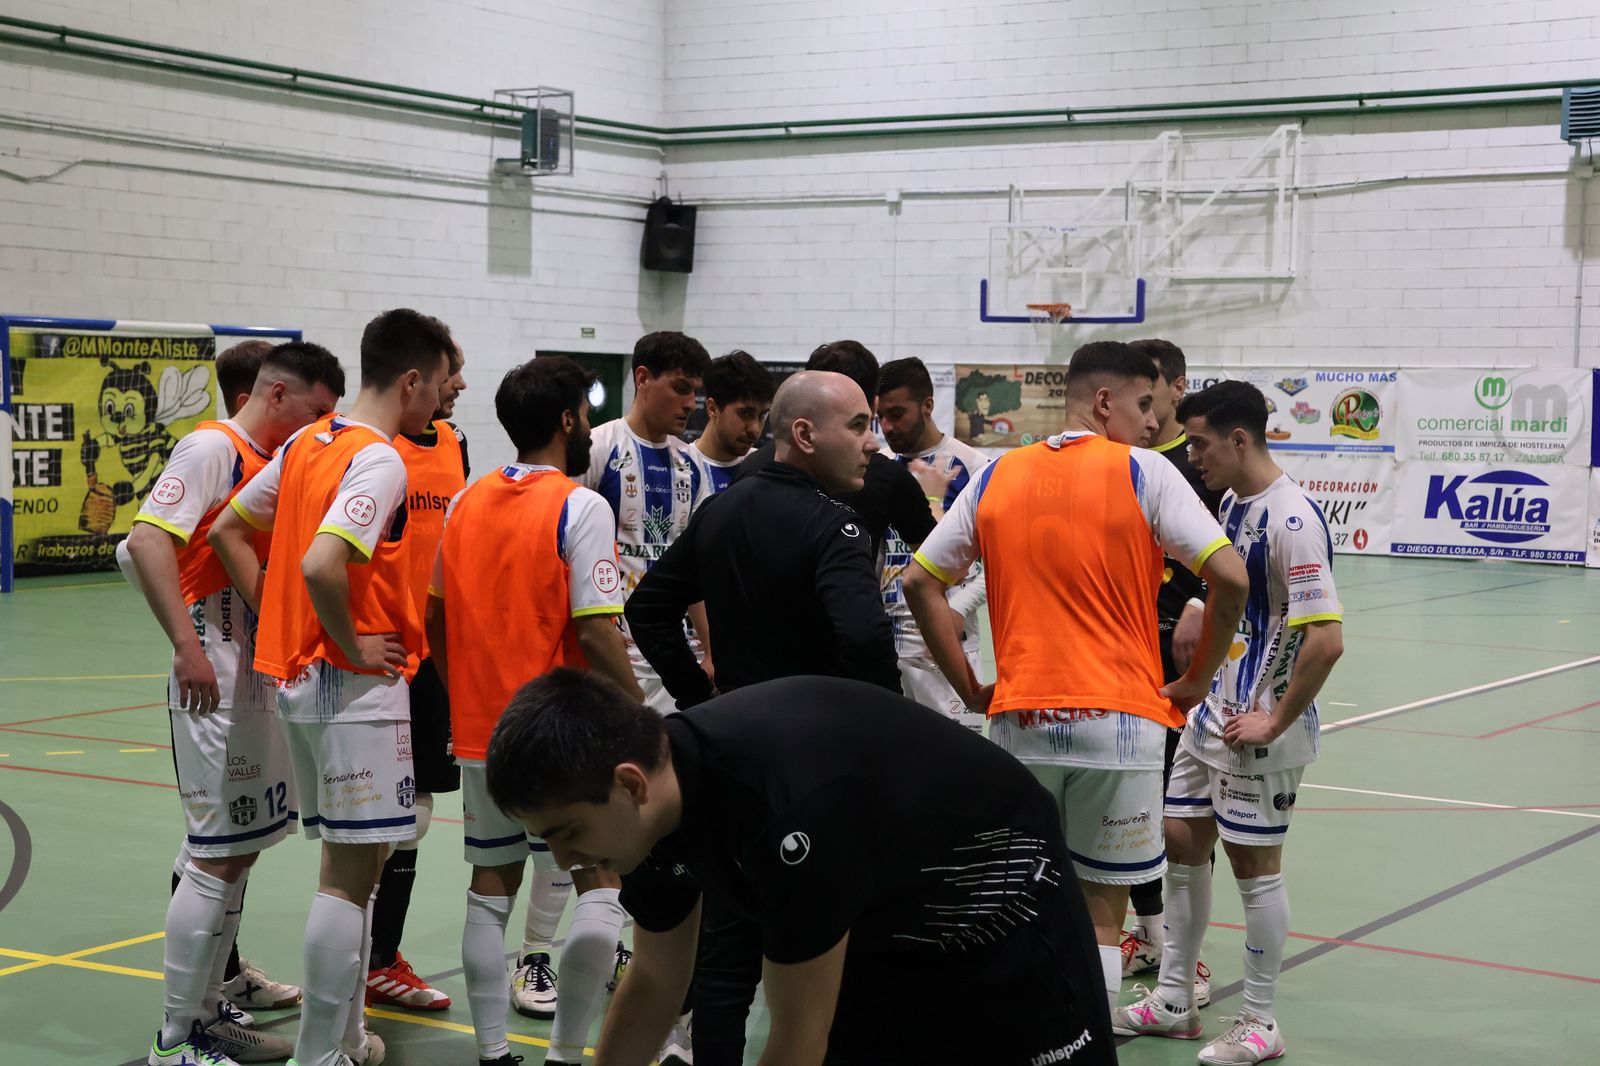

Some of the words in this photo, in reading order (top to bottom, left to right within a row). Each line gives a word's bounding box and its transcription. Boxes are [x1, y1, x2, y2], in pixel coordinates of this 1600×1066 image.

[64, 337, 199, 358] @MMonteAliste
[1315, 372, 1364, 382] MUCHO
[1417, 416, 1504, 431] comercial
[1510, 417, 1568, 433] mardi
[1418, 440, 1463, 448] PRODUCTOS
[1464, 440, 1474, 448] DE
[1475, 441, 1507, 449] LIMPIEZA
[1441, 451, 1461, 461] 680
[1463, 452, 1476, 462] 35
[1479, 453, 1491, 462] 87
[1494, 453, 1505, 463] 17
[1515, 453, 1566, 464] ZAMORA
[1308, 479, 1378, 493] DECORACIÓN
[1424, 474, 1550, 524] Kalúa
[1332, 532, 1348, 546] 37
[1397, 544, 1406, 552] C/
[1406, 545, 1434, 553] DIEGO
[1436, 546, 1448, 554] DE
[1449, 547, 1487, 555] LOSADA,
[1489, 548, 1504, 556] S/N
[1511, 549, 1527, 557] TLF.
[1530, 550, 1545, 558] 980
[1546, 551, 1562, 559] 526
[1564, 552, 1579, 560] 581
[225, 736, 247, 766] LOS
[227, 763, 261, 778] VALLES
[264, 781, 288, 820] 12
[1226, 808, 1257, 819] uhlsport
[1031, 1028, 1093, 1066] uhlsport
